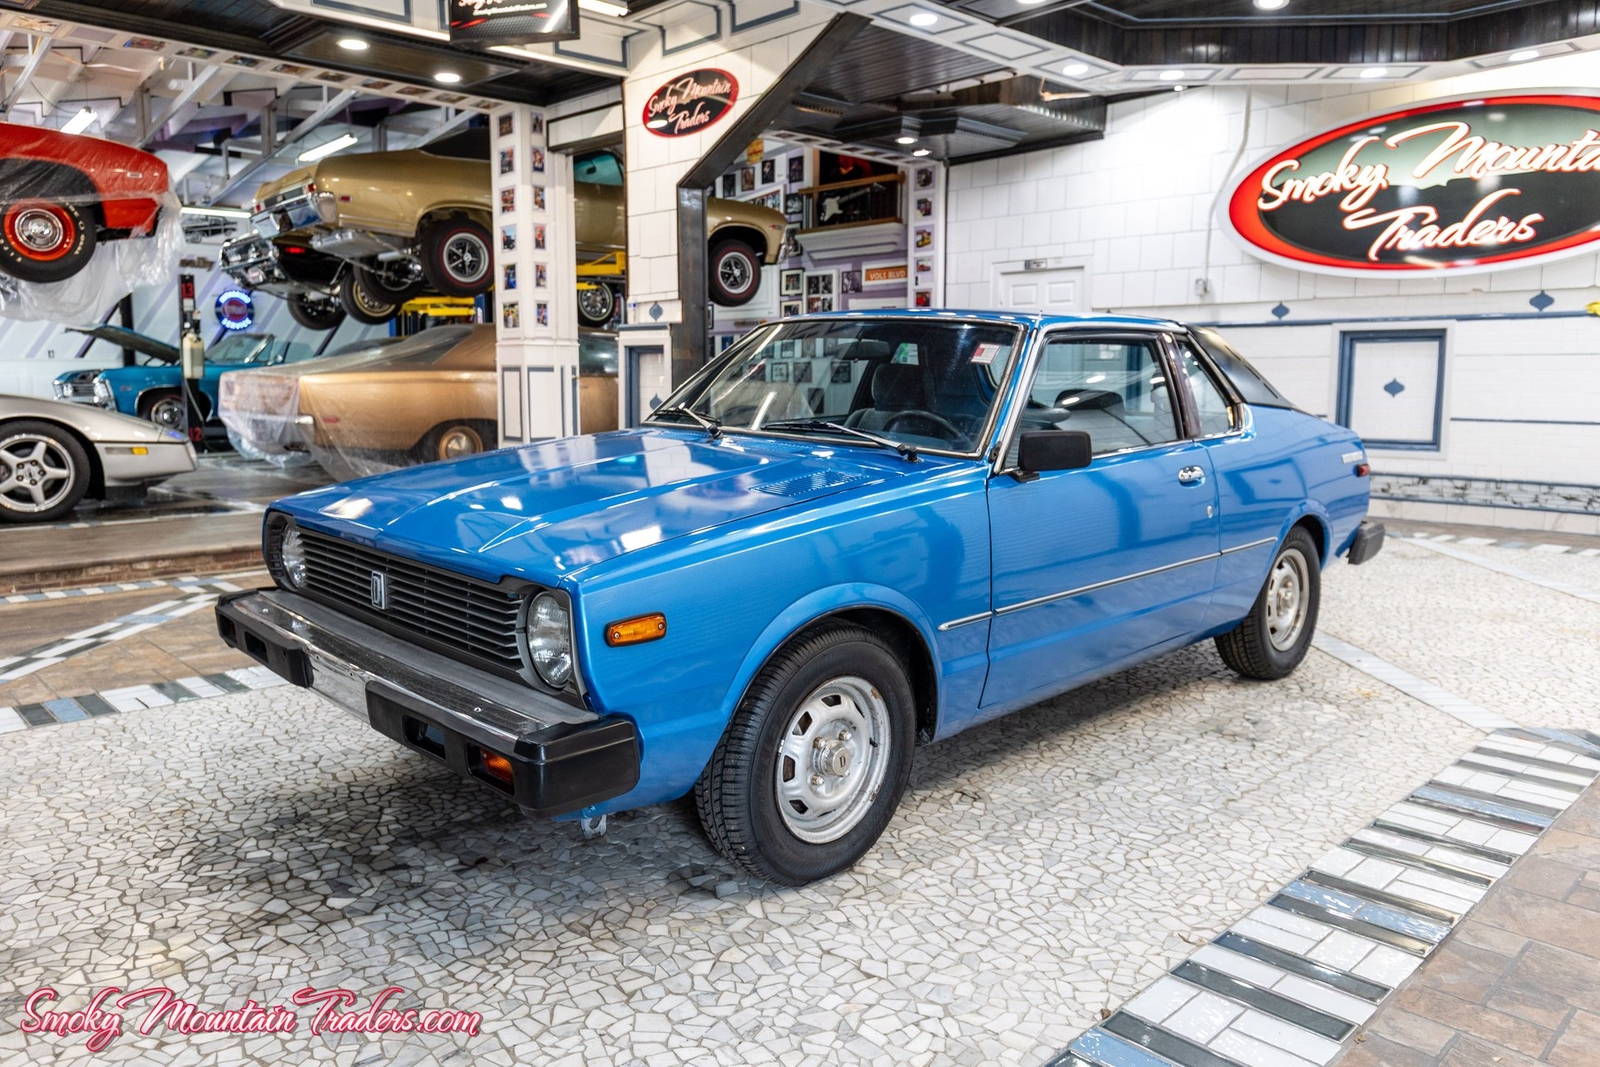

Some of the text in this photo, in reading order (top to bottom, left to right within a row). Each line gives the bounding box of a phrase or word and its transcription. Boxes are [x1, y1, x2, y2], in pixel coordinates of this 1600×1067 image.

[648, 77, 732, 118] Smoky Mountain
[668, 101, 711, 134] Traders
[1257, 135, 1389, 211] Smoky
[1342, 188, 1546, 262] Traders
[869, 270, 906, 280] VOLS BLVD
